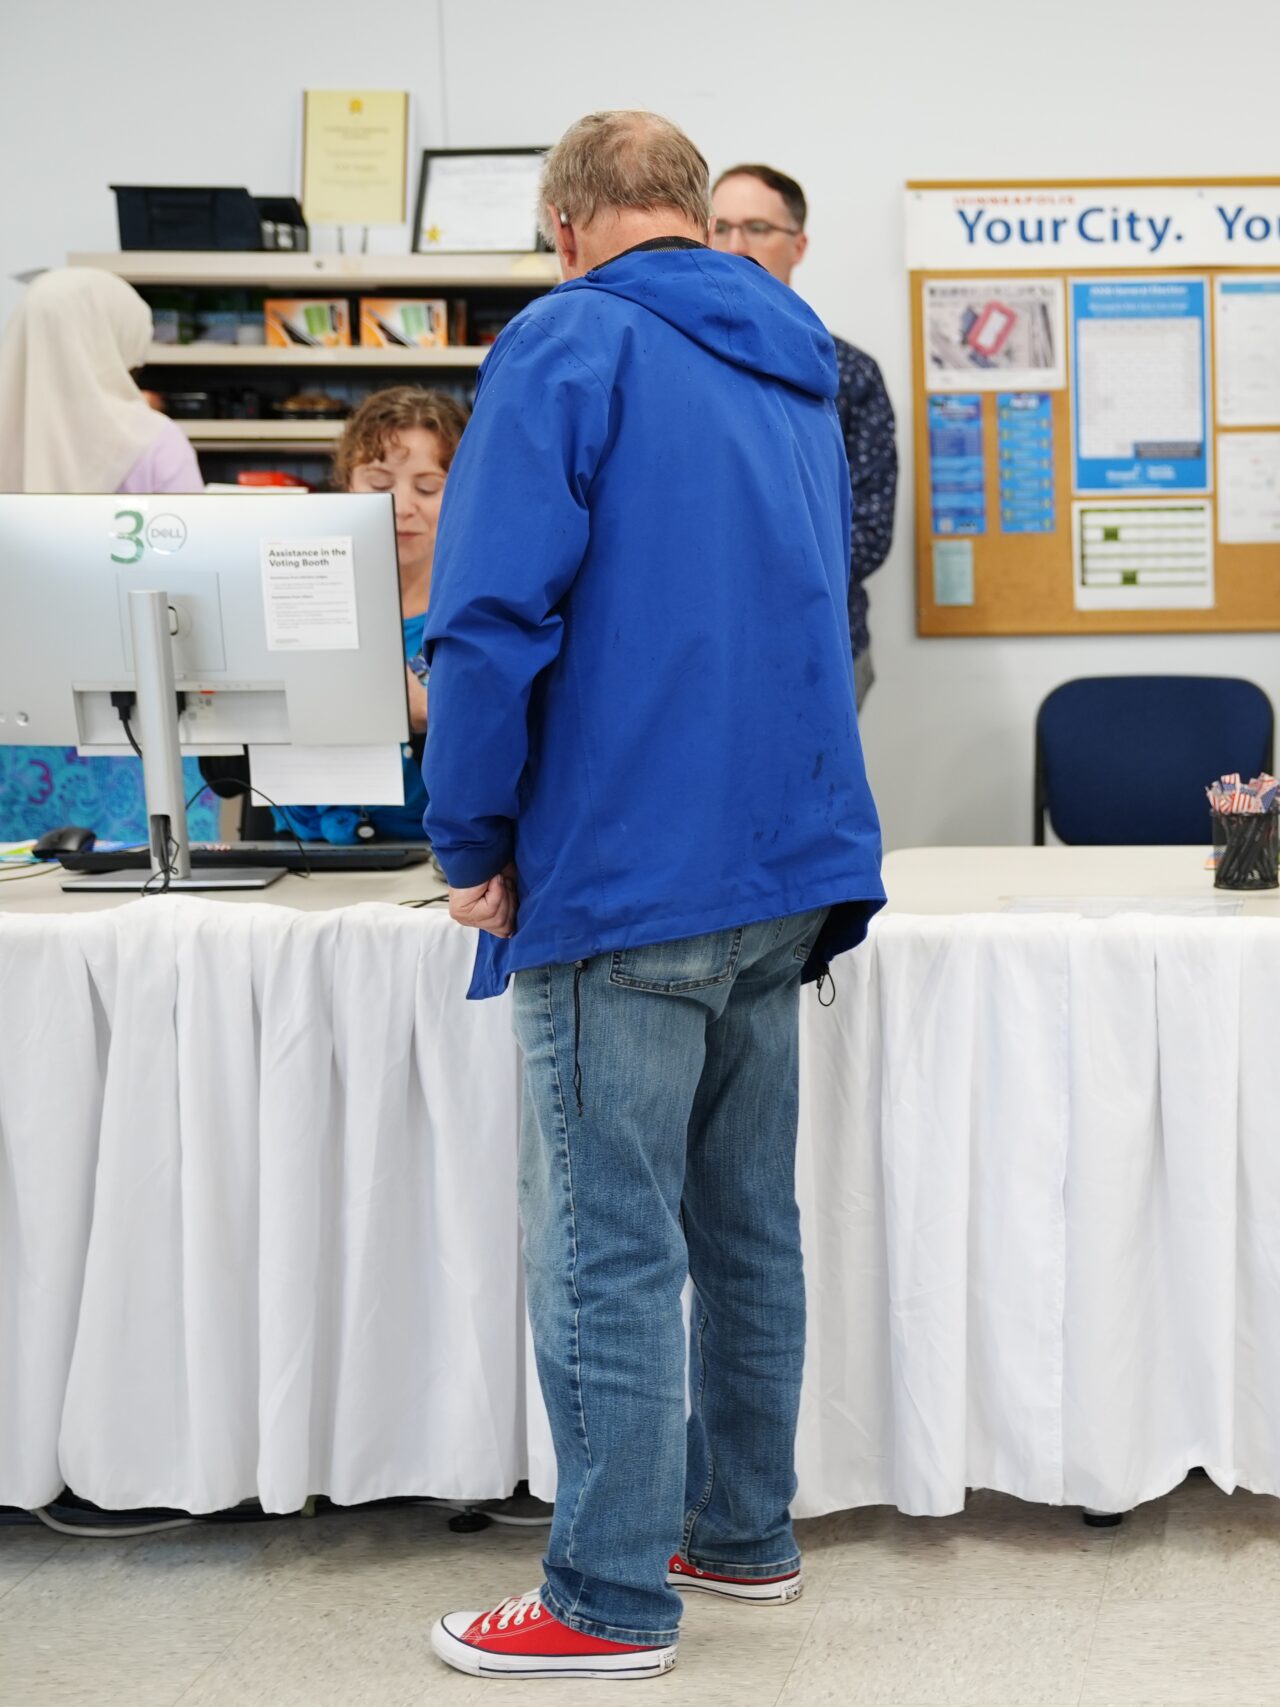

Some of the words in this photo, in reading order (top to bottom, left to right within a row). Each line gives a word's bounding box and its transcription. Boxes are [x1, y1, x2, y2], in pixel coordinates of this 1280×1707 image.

[957, 208, 1068, 245] Your
[1077, 206, 1184, 253] City.
[110, 510, 145, 564] 3
[151, 528, 182, 539] DELL
[268, 548, 319, 558] Assistance
[320, 547, 330, 557] in
[331, 547, 348, 557] the
[268, 559, 300, 569] Voting
[301, 558, 330, 568] Booth
